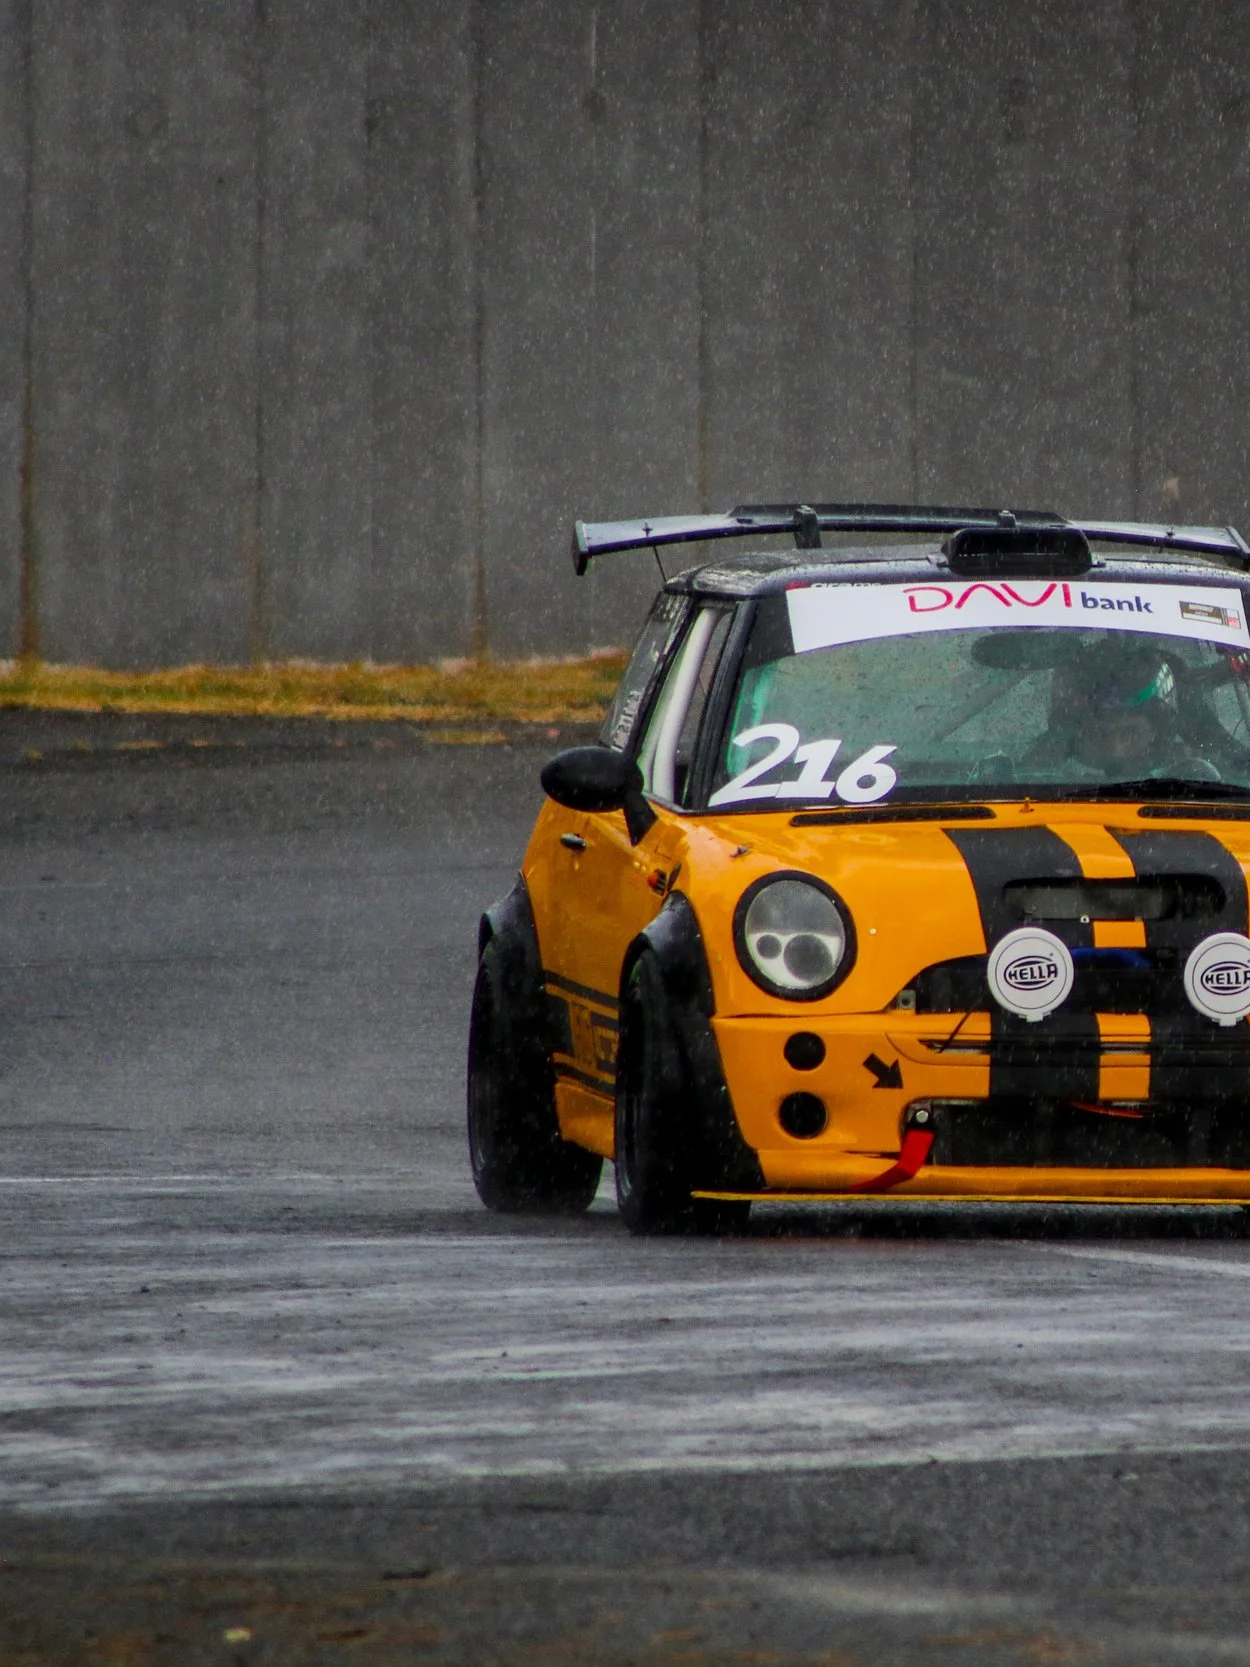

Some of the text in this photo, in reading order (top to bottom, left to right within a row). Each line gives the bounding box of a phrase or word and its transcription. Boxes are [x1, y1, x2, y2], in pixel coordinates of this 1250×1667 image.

[1081, 591, 1154, 613] bank
[708, 722, 898, 807] 216
[1008, 963, 1058, 981] HELLA
